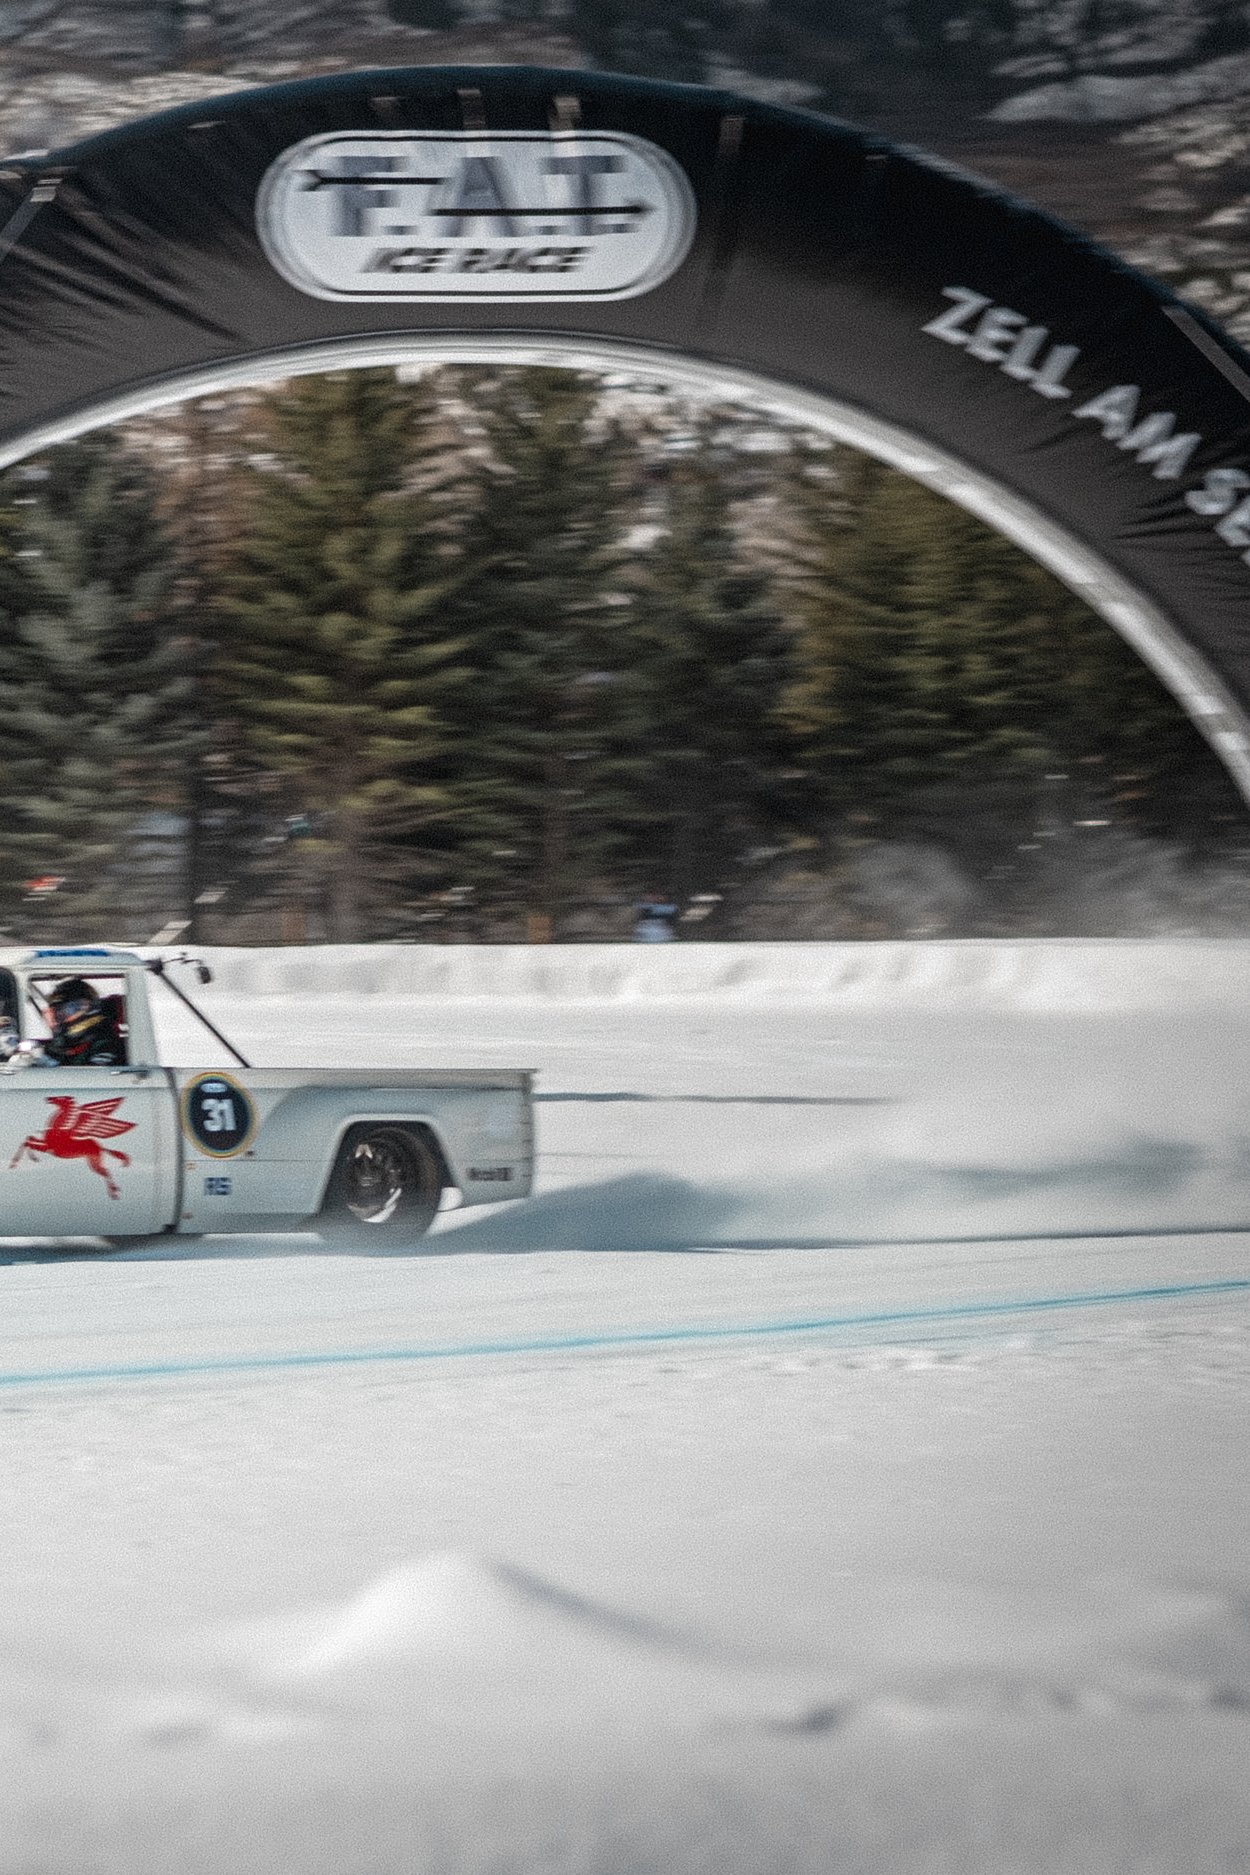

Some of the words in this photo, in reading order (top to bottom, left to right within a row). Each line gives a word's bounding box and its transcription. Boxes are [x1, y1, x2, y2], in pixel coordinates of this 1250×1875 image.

[361, 246, 449, 274] ICE
[456, 246, 594, 274] RACE
[921, 285, 1082, 399] ZELL
[1071, 384, 1204, 481] AM
[200, 1098, 237, 1132] 31
